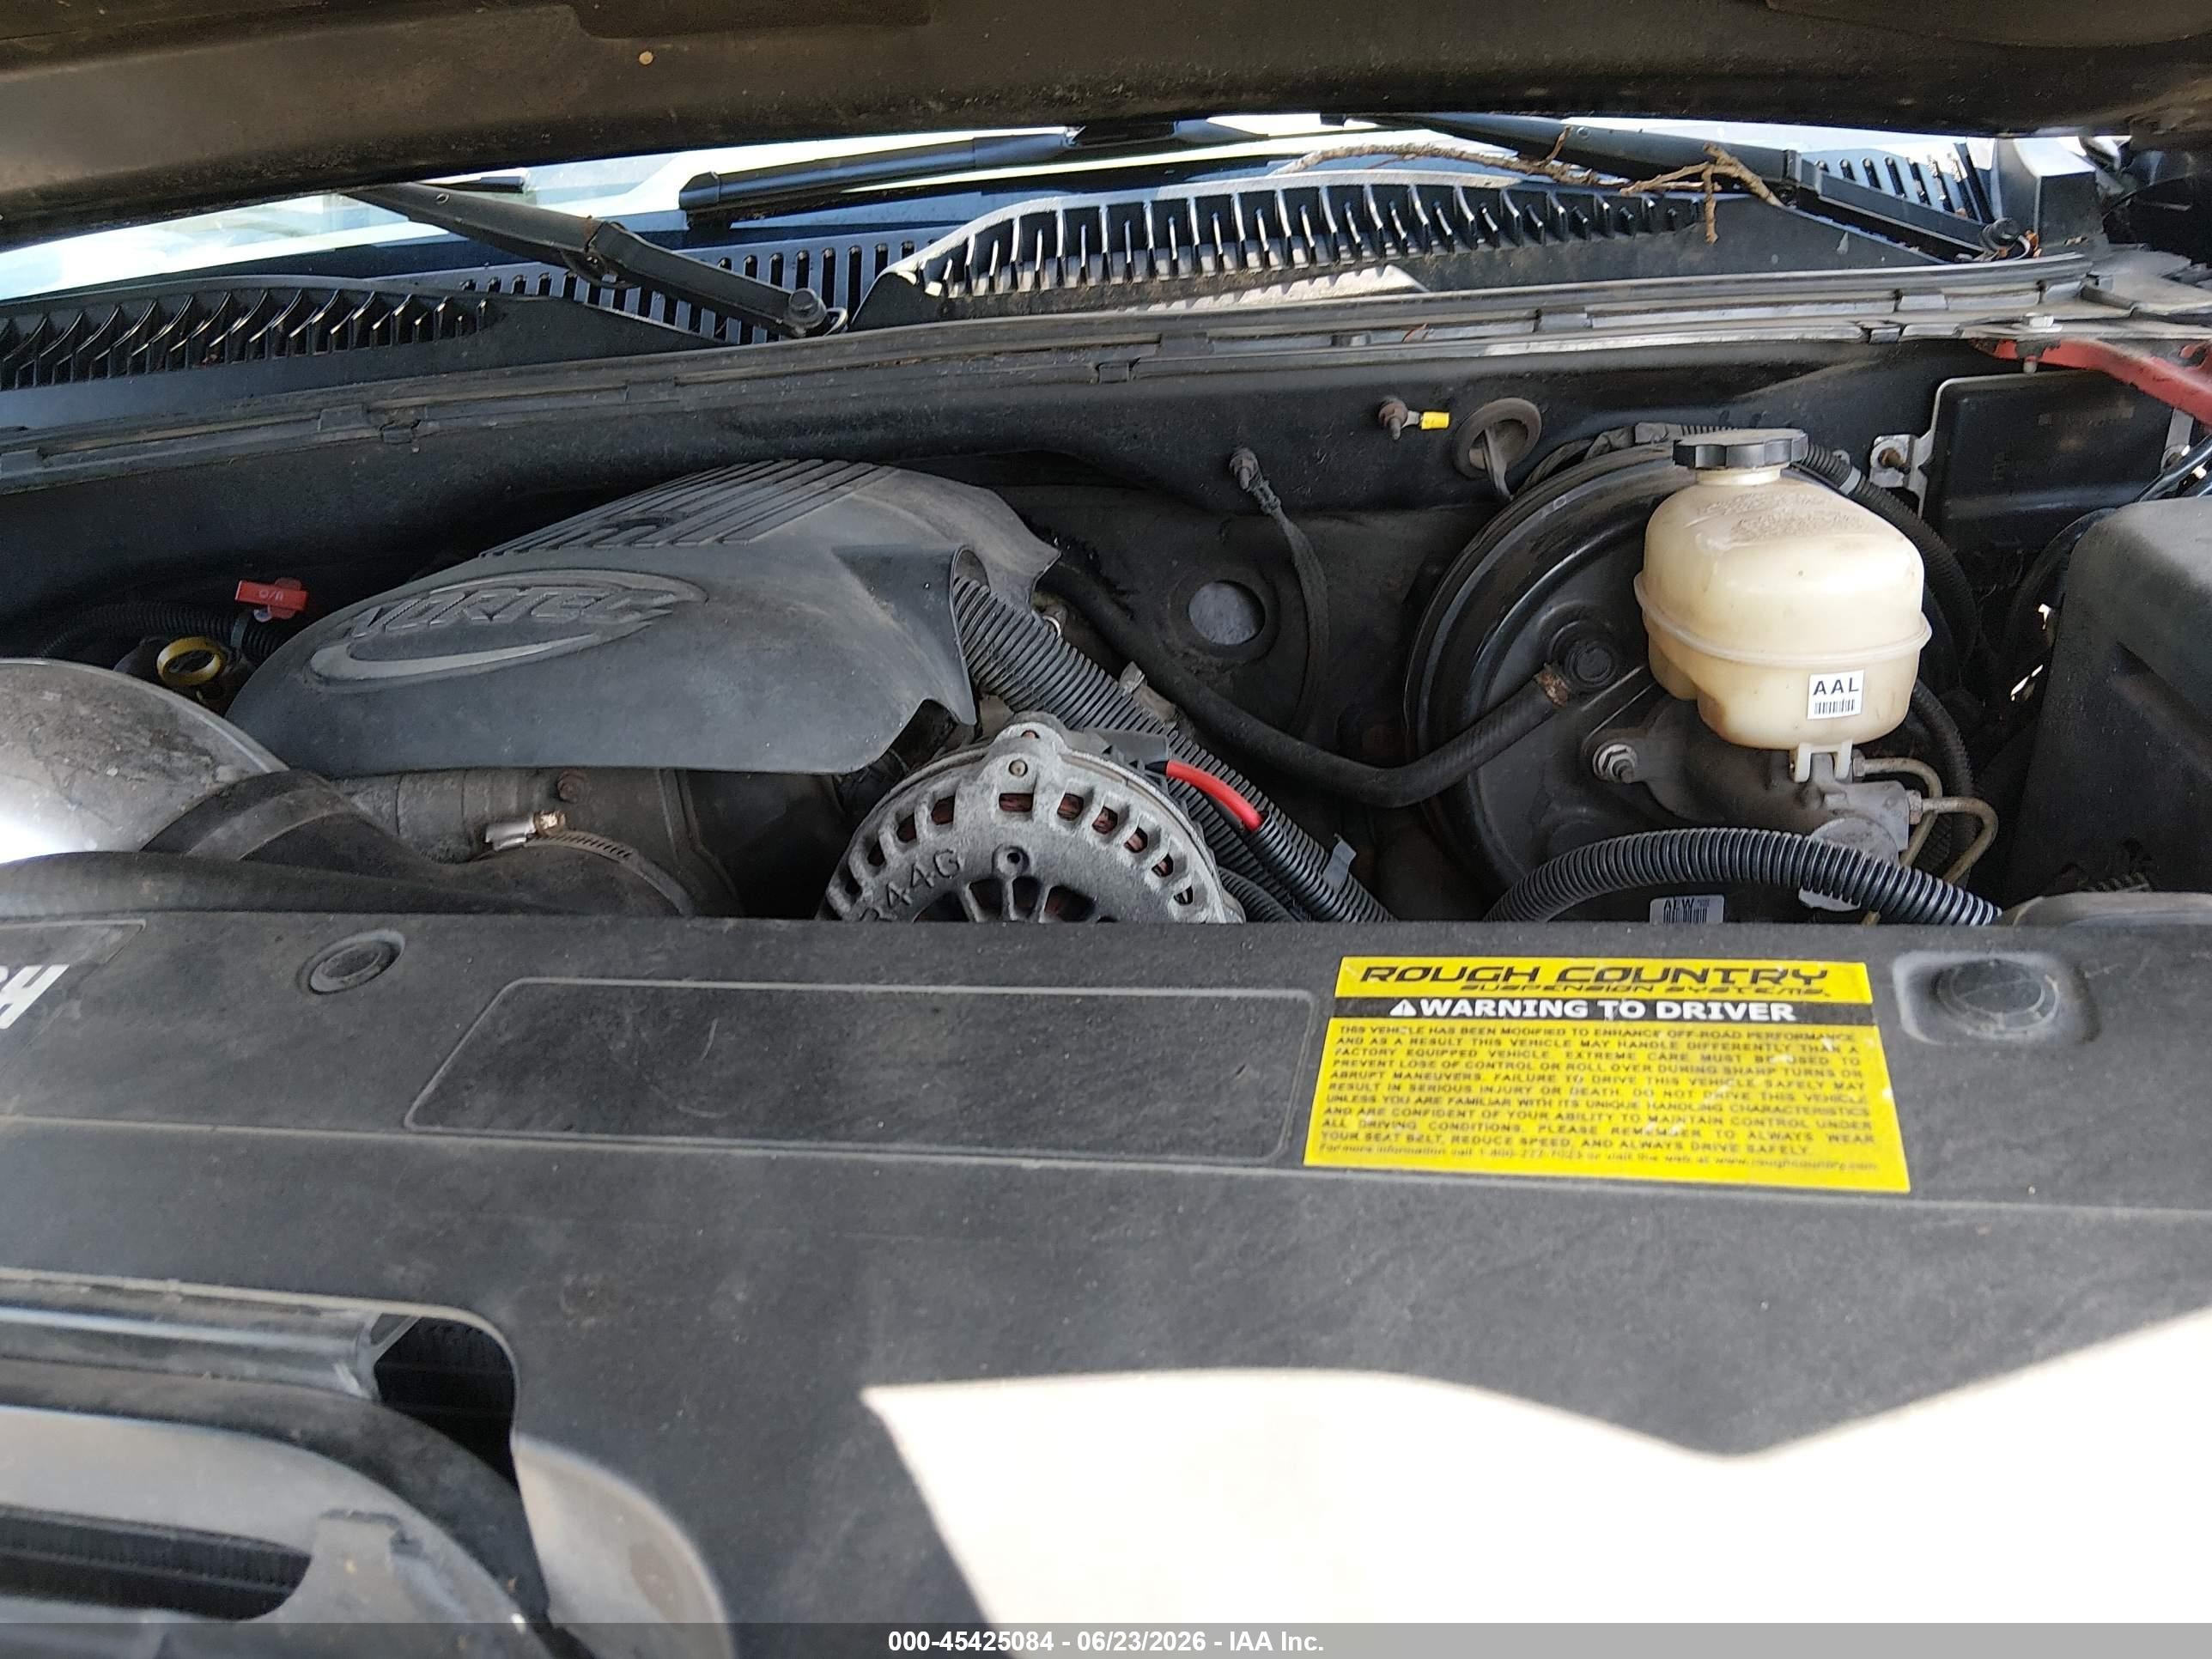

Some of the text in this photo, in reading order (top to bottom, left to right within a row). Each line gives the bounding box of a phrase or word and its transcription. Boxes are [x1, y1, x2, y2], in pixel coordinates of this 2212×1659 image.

[1813, 677, 1860, 696] AAL
[1360, 965, 1830, 985] ROUGH COUNTRY
[1460, 982, 1653, 993] SUSPENSION
[1418, 998, 1796, 1021] WARNING TO DRIVER
[1667, 1030, 1742, 1039] OFF-ROAD
[1746, 1031, 1855, 1041] PERFORMANCE
[1334, 1048, 1395, 1056] FACTORY
[1406, 1049, 1478, 1058] EQUIPPED
[1565, 1052, 1636, 1061] EXTREME
[1647, 1054, 1689, 1062] CARE
[1699, 1054, 1742, 1063] MUST
[1784, 1056, 1830, 1065] USED
[1686, 1042, 1791, 1052] DIFFERENTLY
[1800, 1044, 1841, 1053] THAN
[1332, 1059, 1395, 1067] PREVENT
[1464, 1061, 1534, 1071] CONTROL
[1610, 1065, 1651, 1073] OVER
[1658, 1066, 1717, 1074] DURING
[1723, 1067, 1777, 1076] SHARP
[1783, 1068, 1836, 1077] TURNS
[1839, 1069, 1863, 1078] OR
[1329, 1070, 1385, 1079] ABRUPT
[1493, 1074, 1556, 1083] FAILURE
[1565, 1075, 1583, 1084] TO
[1591, 1076, 1637, 1085] DRIVE
[1688, 1079, 1757, 1087] VEHICLE
[1765, 1080, 1825, 1089] SAFELY
[1832, 1081, 1865, 1090] MAY
[1328, 1082, 1381, 1091] RESULT
[1407, 1084, 1473, 1093] SERIOUS
[1479, 1085, 1531, 1095] INJURY
[1662, 1090, 1693, 1098] NOT
[1703, 1091, 1750, 1100] DRIVE
[1759, 1092, 1796, 1102] THIS
[1803, 1094, 1867, 1103] VEHICLE
[1325, 1094, 1376, 1103] UNLESS
[1446, 1097, 1511, 1107] FAMILIAR
[1516, 1099, 1553, 1108] WITH
[1558, 1100, 1580, 1109] ITS
[1585, 1101, 1641, 1110] UNIQUE
[1646, 1103, 1723, 1112] HANDLING
[1729, 1104, 1870, 1116] CHARACTERISTICS
[1323, 1106, 1872, 1130] AND ARE CONFIDENT OF YOUR ABILITY TO MAINTAIN CONTROL UNDER
[1321, 1118, 1346, 1127] ALL
[1357, 1120, 1418, 1129] DRIVING
[1537, 1125, 1597, 1134] PLEASE
[1715, 1130, 1735, 1139] TO
[1747, 1131, 1814, 1142] ALWAYS
[1826, 1133, 1875, 1144] WEAR
[1319, 1131, 1359, 1140] YOUR
[1364, 1133, 1401, 1142] SEAT
[1449, 1135, 1512, 1146] REDUCE
[1581, 1139, 1613, 1149] AND
[1619, 1140, 1683, 1151] ALWAYS
[1690, 1143, 1740, 1152] DRIVE
